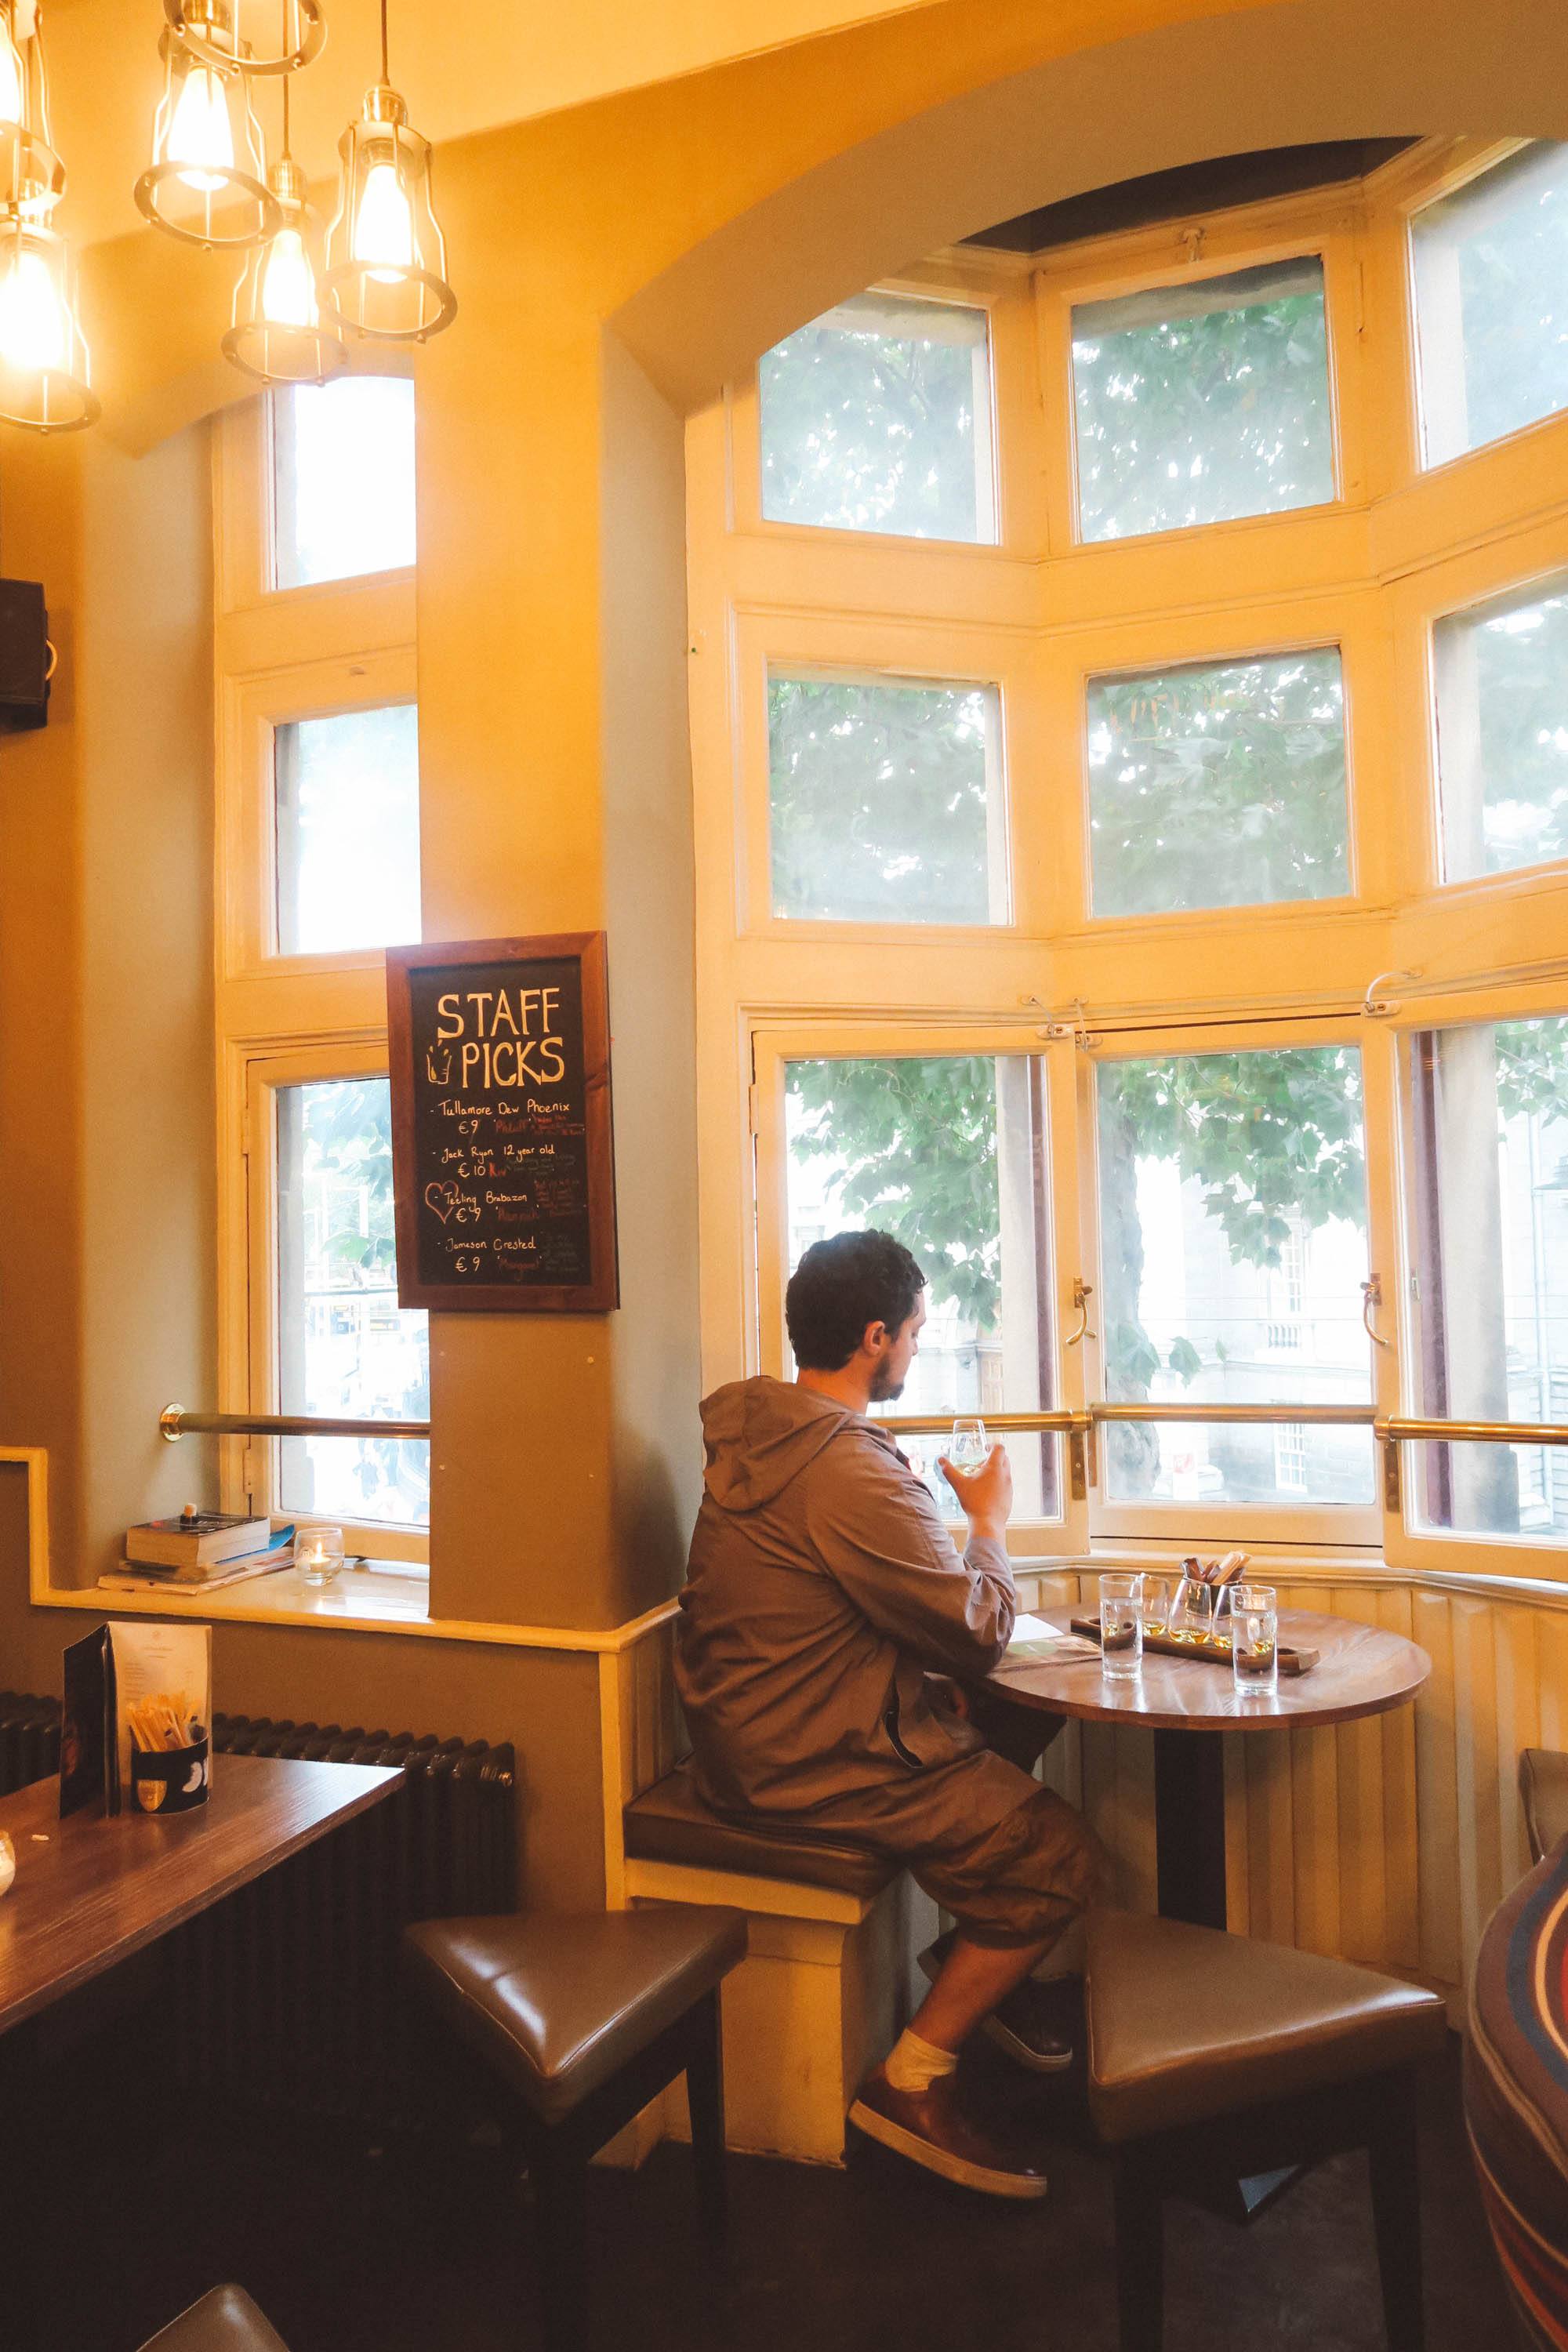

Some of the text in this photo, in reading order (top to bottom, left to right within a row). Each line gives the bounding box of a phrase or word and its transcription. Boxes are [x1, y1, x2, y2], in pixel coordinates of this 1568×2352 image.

[437, 988, 559, 1038] STAFF
[462, 1037, 564, 1088] PICKS
[438, 1099, 569, 1116] Tullamore Dew Phoenix
[441, 1145, 555, 1164] Jack Ryan 12 year old
[445, 1192, 477, 1212] Teeling
[486, 1191, 527, 1203] Brabazon
[446, 1236, 536, 1252] Jameson Crested
